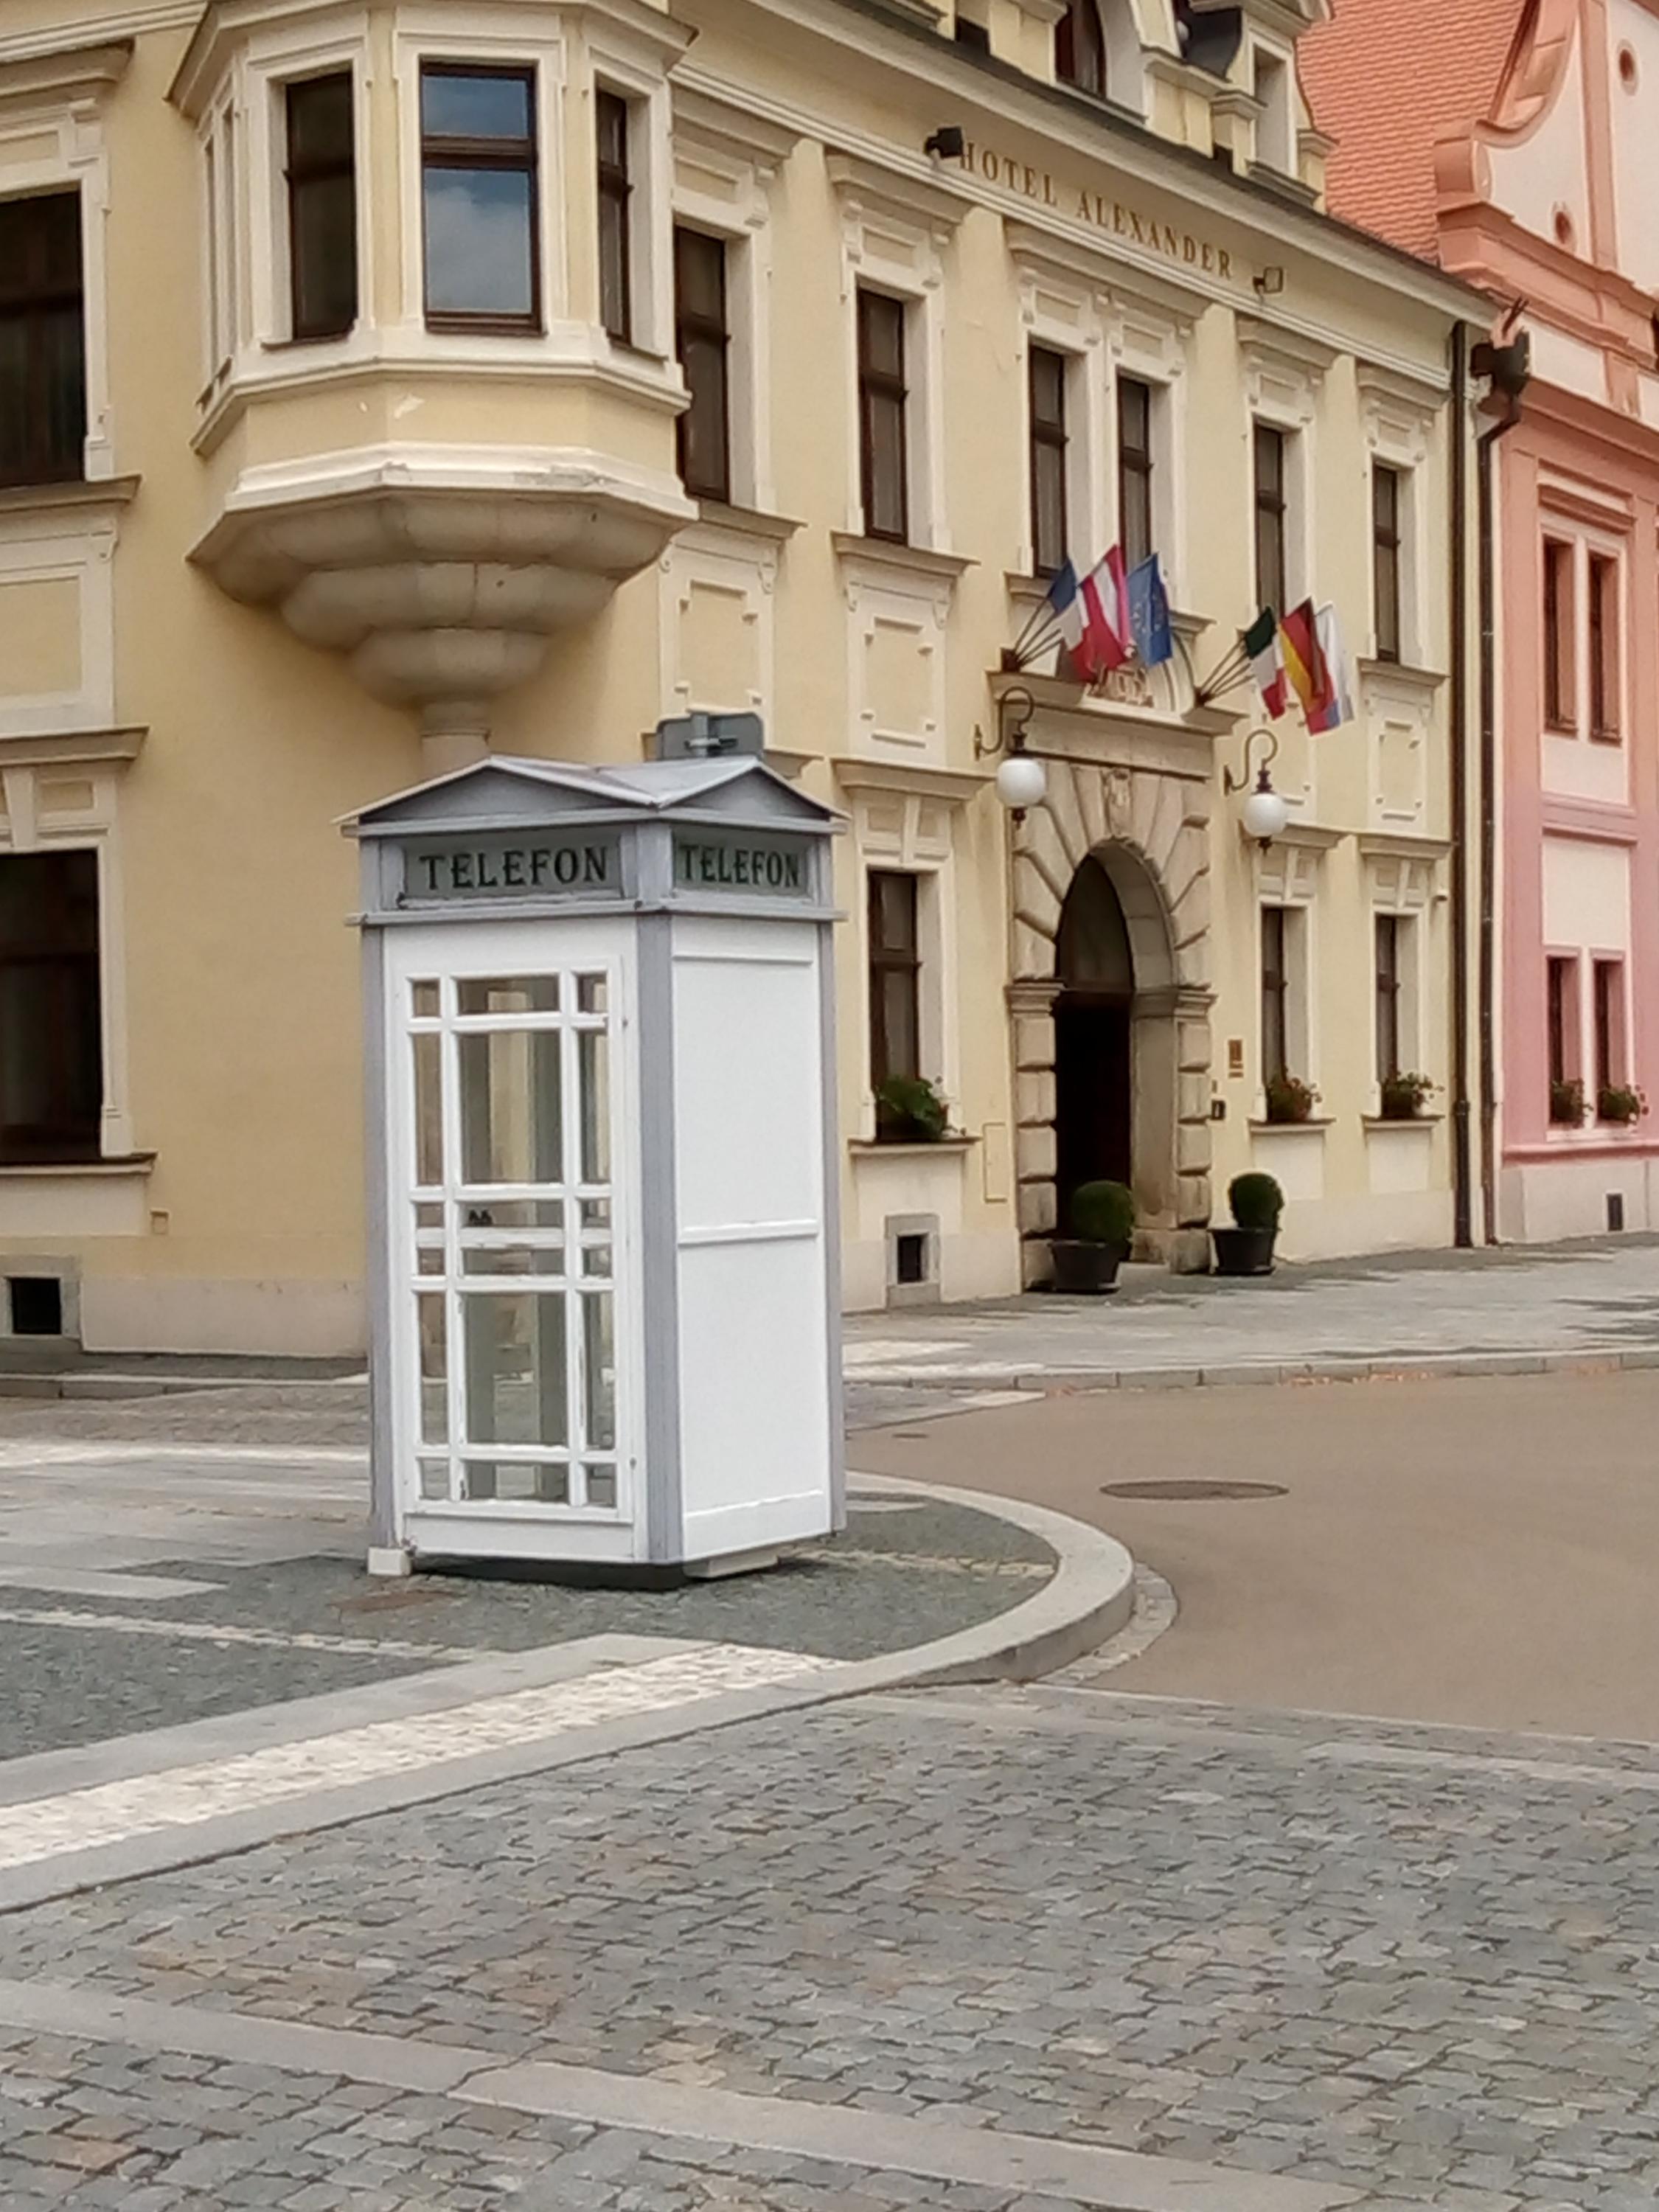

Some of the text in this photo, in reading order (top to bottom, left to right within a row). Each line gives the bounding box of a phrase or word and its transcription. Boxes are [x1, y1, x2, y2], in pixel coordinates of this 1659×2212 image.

[960, 142, 1233, 280] HOTEL ALEXANDER
[419, 846, 607, 890] TELEFON
[678, 844, 799, 887] TELEFON
